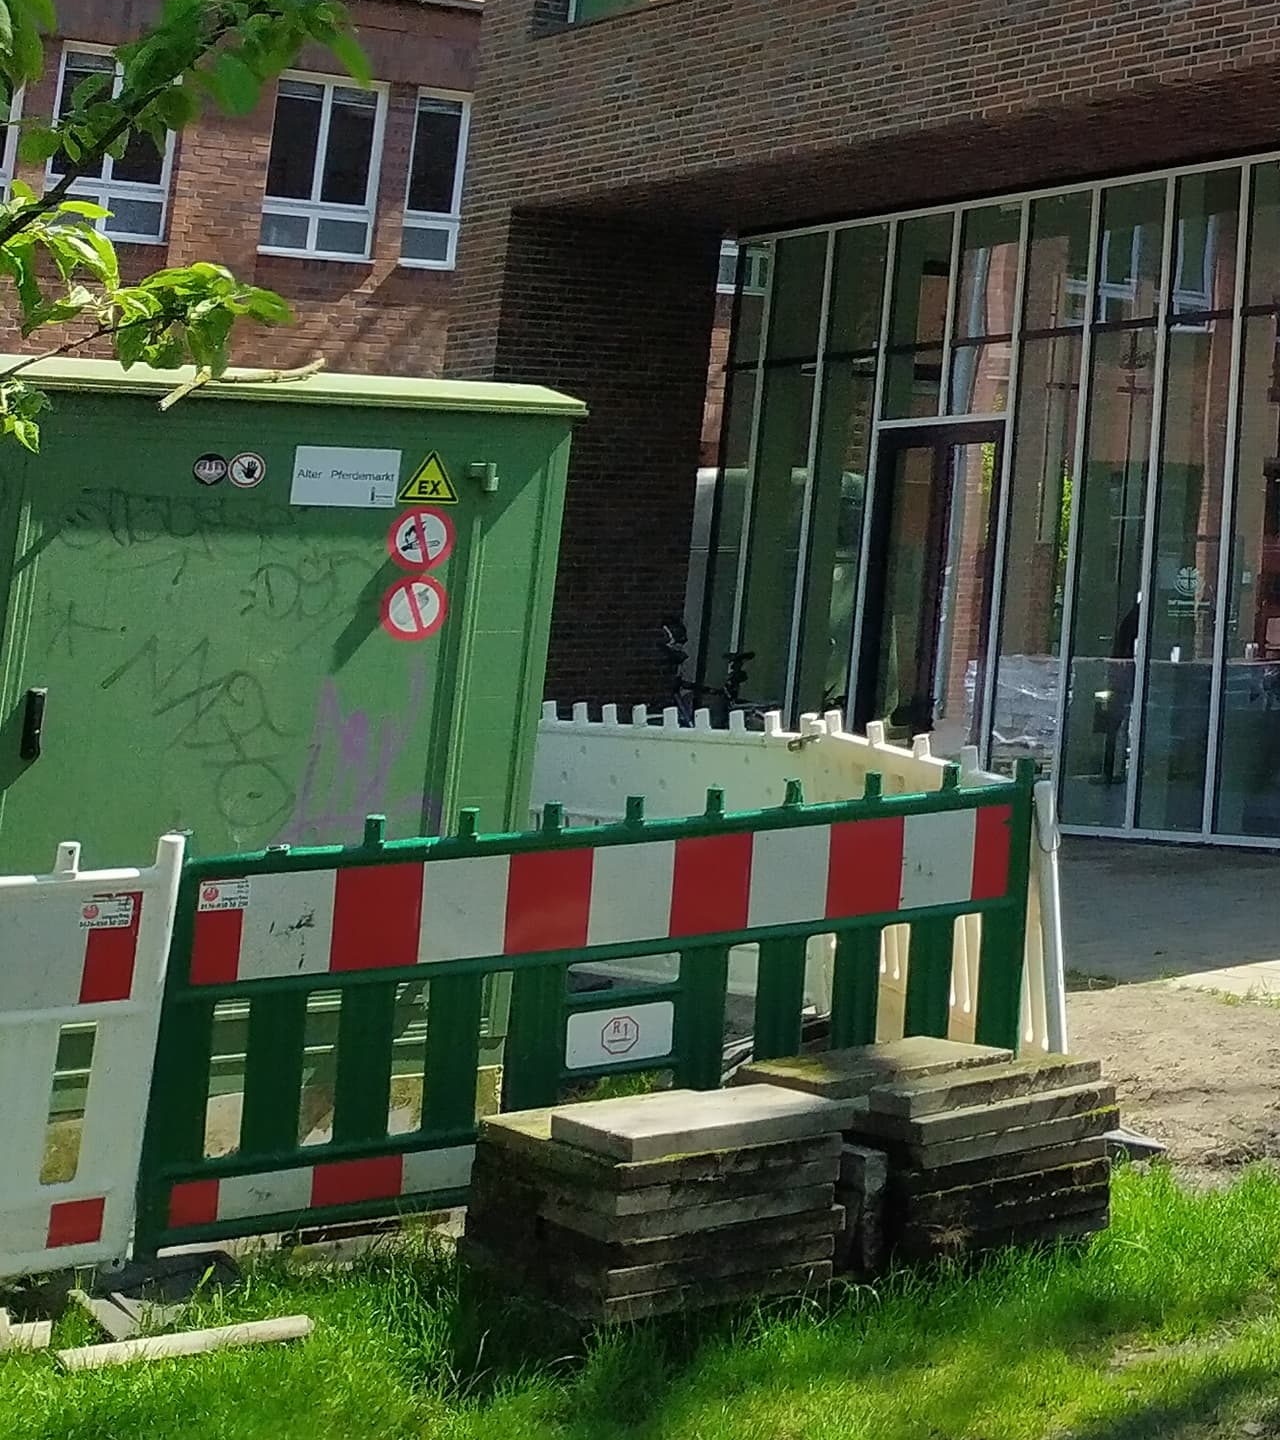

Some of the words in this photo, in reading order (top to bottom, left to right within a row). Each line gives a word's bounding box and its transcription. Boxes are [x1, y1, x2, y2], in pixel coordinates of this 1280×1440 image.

[298, 468, 322, 479] Alter
[331, 469, 395, 482] Pferdemarkt
[417, 479, 442, 495] EX
